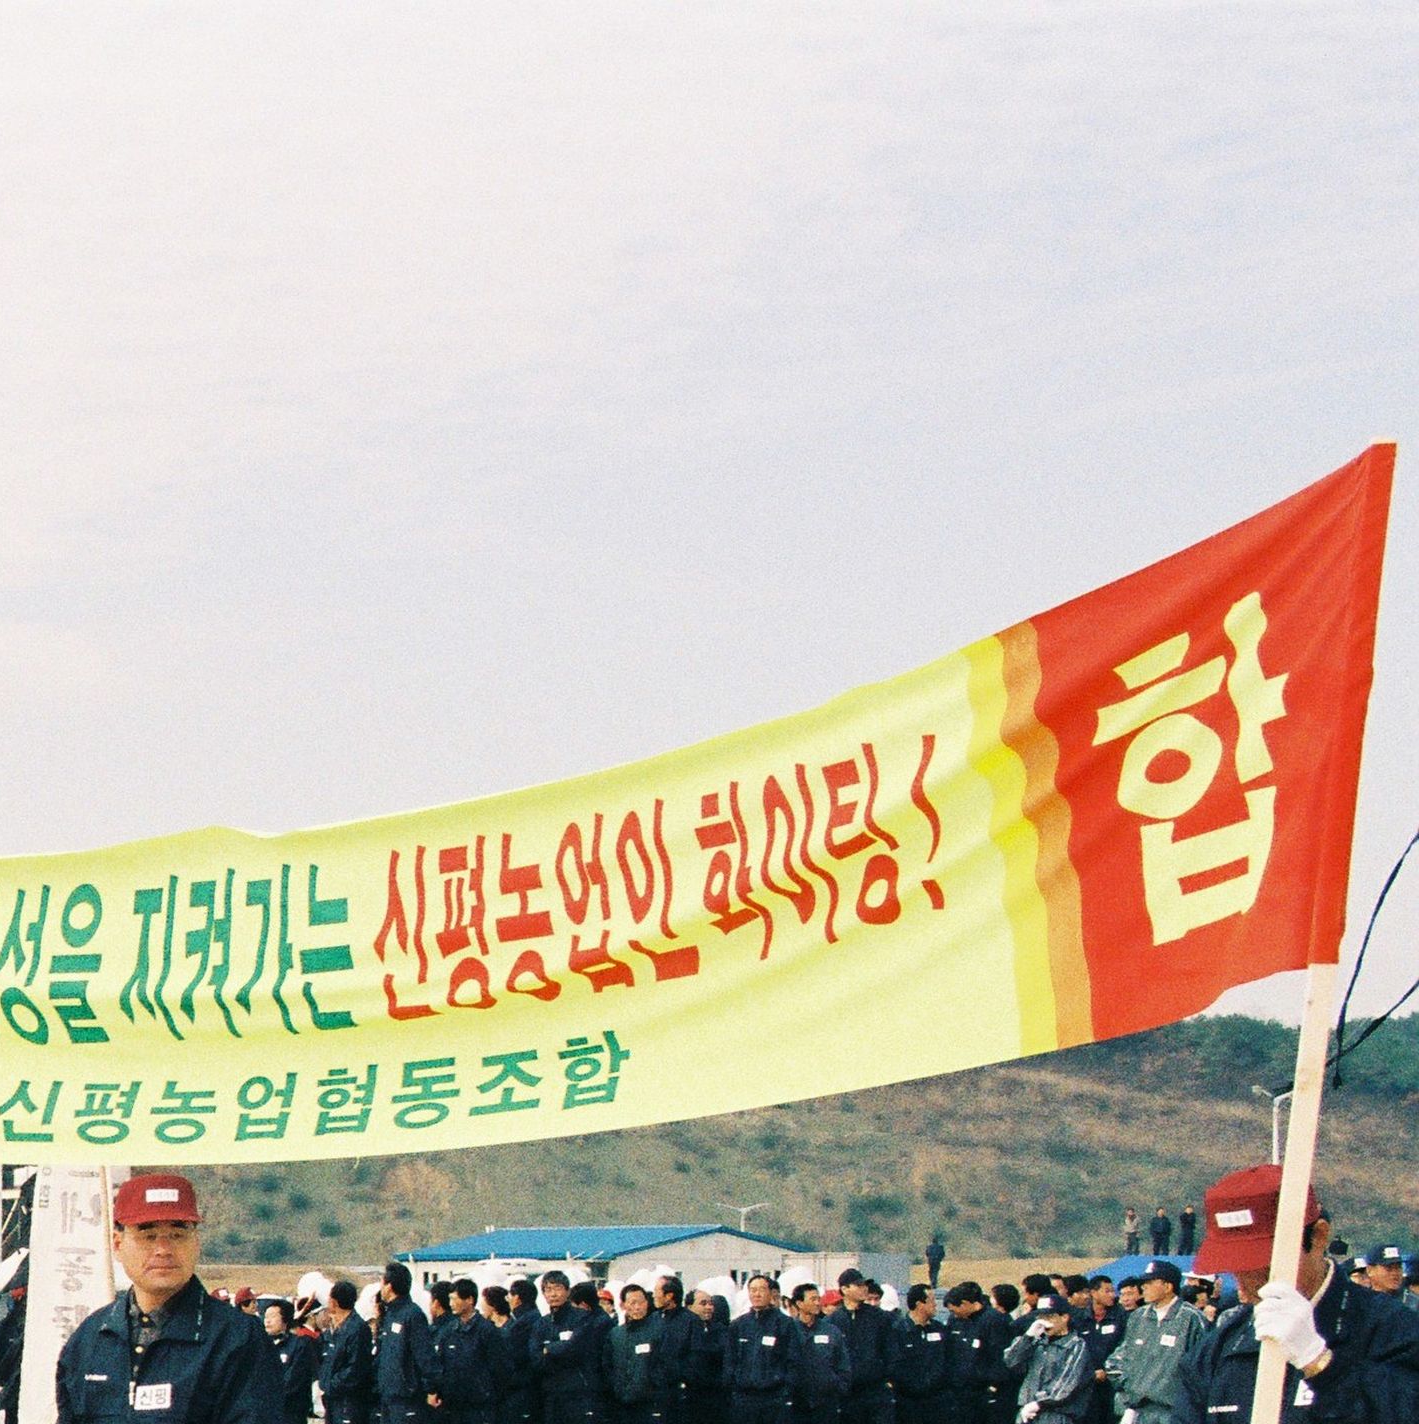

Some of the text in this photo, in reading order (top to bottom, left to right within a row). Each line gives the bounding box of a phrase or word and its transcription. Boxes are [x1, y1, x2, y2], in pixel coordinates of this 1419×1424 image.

[1093, 590, 1290, 947] 합
[119, 863, 359, 1041] 지켜가는
[373, 798, 701, 1021] 신평농업인
